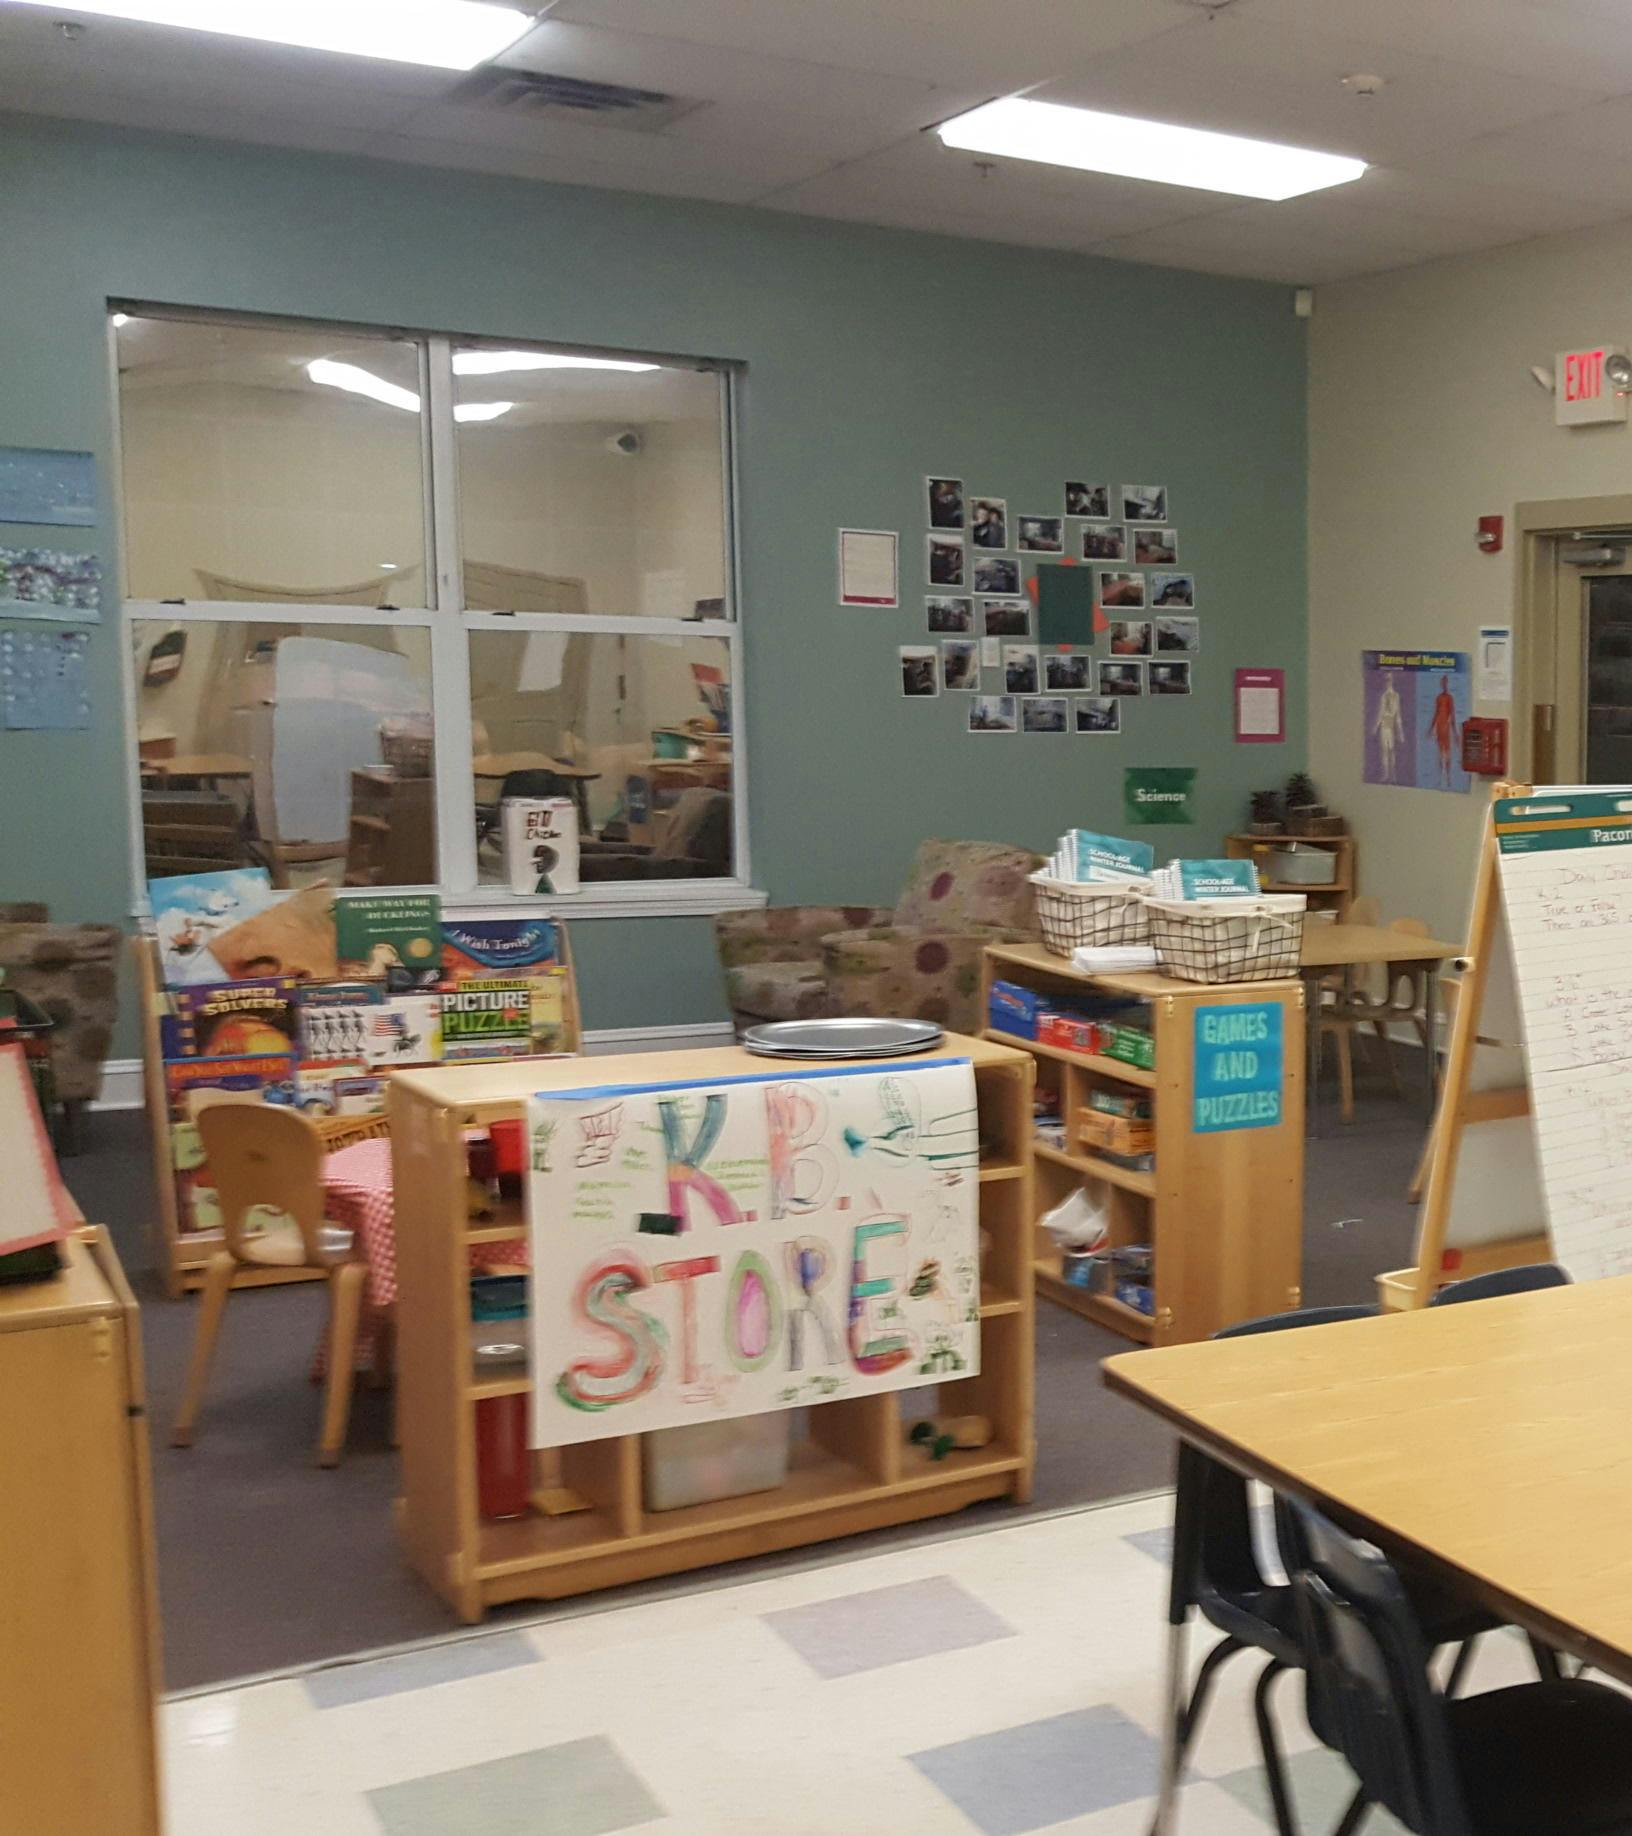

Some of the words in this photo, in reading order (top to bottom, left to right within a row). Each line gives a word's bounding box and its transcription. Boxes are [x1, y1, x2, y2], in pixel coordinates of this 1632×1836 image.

[1565, 348, 1603, 401] EXIT
[1406, 656, 1422, 665] and
[1135, 787, 1186, 802] Science
[460, 934, 490, 950] Wish
[212, 986, 276, 1002] SUPER
[461, 981, 482, 989] THE
[483, 979, 529, 988] ULTIMATE
[203, 998, 288, 1016] SOLVERS
[443, 990, 529, 1012] PICTURE
[1203, 1010, 1268, 1045] GAMES
[1215, 1051, 1258, 1082] AND
[1199, 1090, 1280, 1127] PUZZLES
[555, 1213, 914, 1412] STORE
